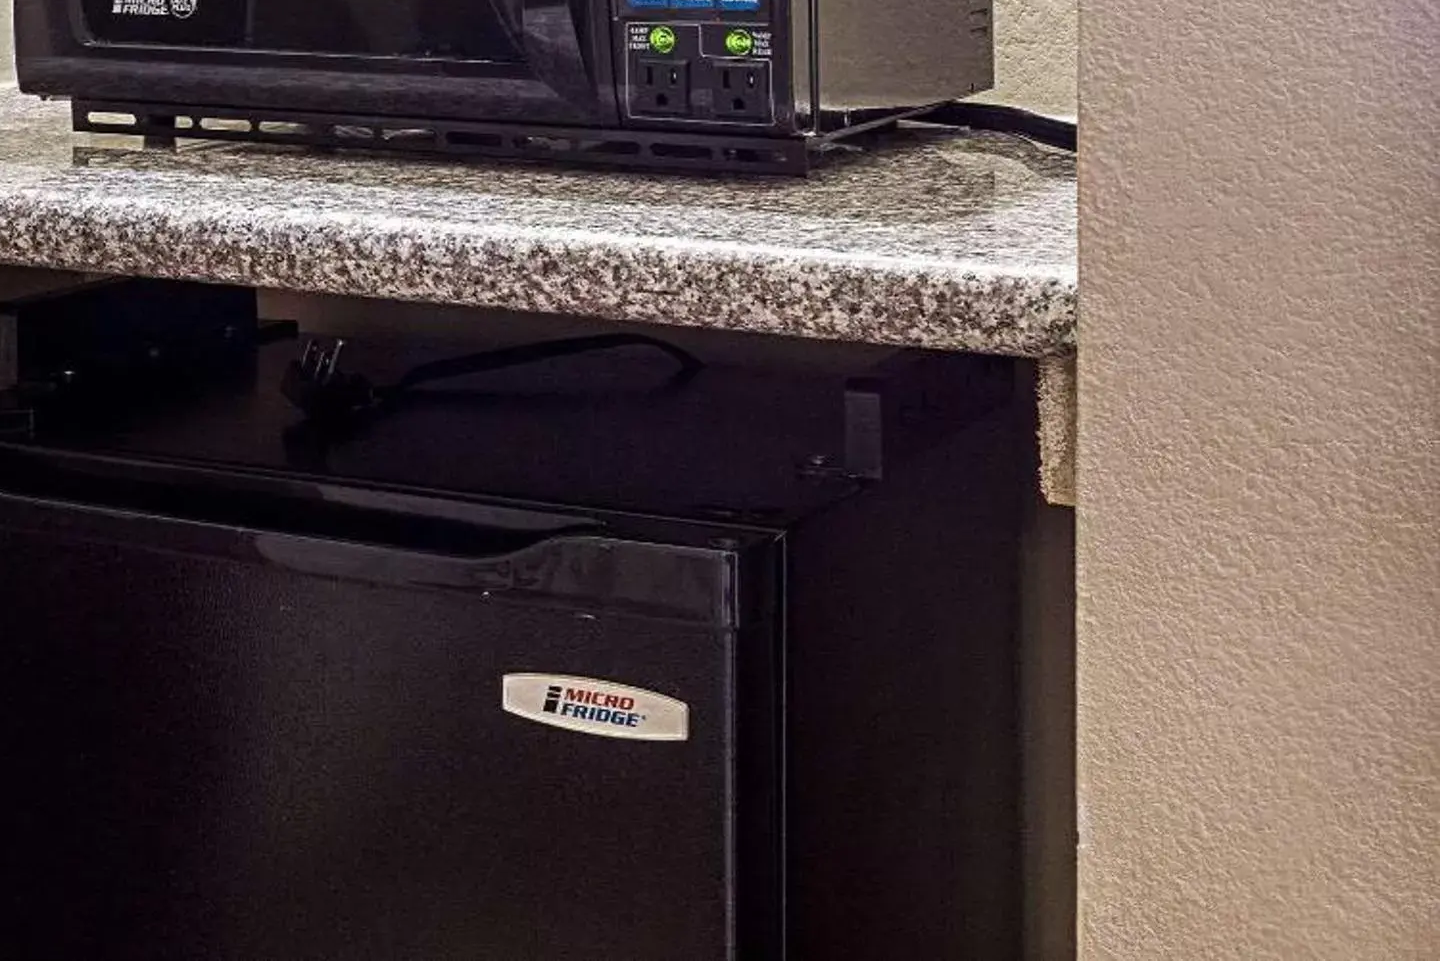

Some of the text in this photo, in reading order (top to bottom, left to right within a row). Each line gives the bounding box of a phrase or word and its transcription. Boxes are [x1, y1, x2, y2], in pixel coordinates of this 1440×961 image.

[122, 4, 170, 15] FRIDGE
[565, 689, 634, 710] MICRO
[561, 704, 640, 727] FRIDGE
